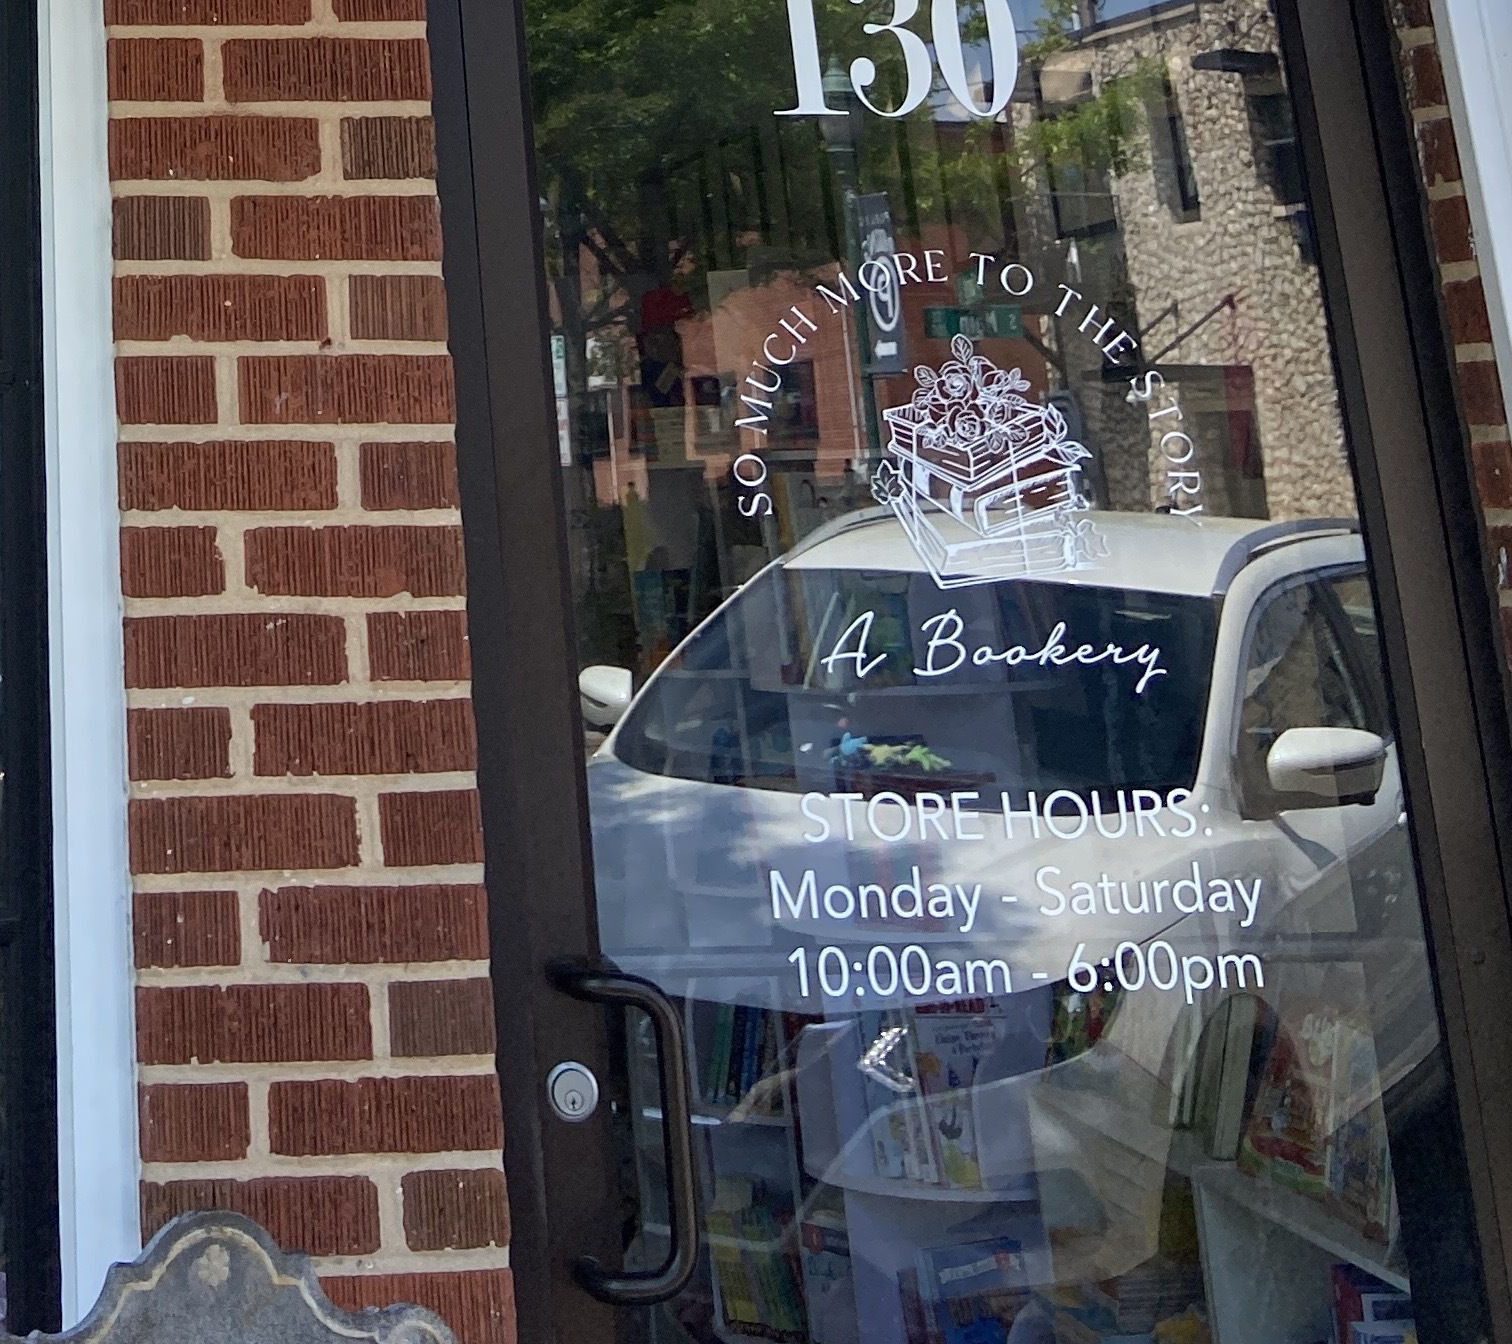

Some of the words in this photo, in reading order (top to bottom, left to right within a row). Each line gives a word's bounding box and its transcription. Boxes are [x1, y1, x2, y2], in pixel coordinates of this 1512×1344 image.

[816, 250, 948, 315] MORE
[969, 251, 1034, 296] TO
[1054, 283, 1138, 365] THE
[734, 305, 818, 436] MUCH
[1129, 370, 1204, 527] STORY
[733, 453, 773, 517] SO
[821, 610, 886, 678] A
[913, 609, 1167, 694] Bookery
[801, 790, 985, 843] STORE
[1002, 788, 1214, 840] HOURS:
[771, 866, 983, 933] Monday
[1037, 861, 1263, 928] Saturday
[788, 945, 1012, 998] 10:00am
[1068, 940, 1265, 1004] 6:00pm
